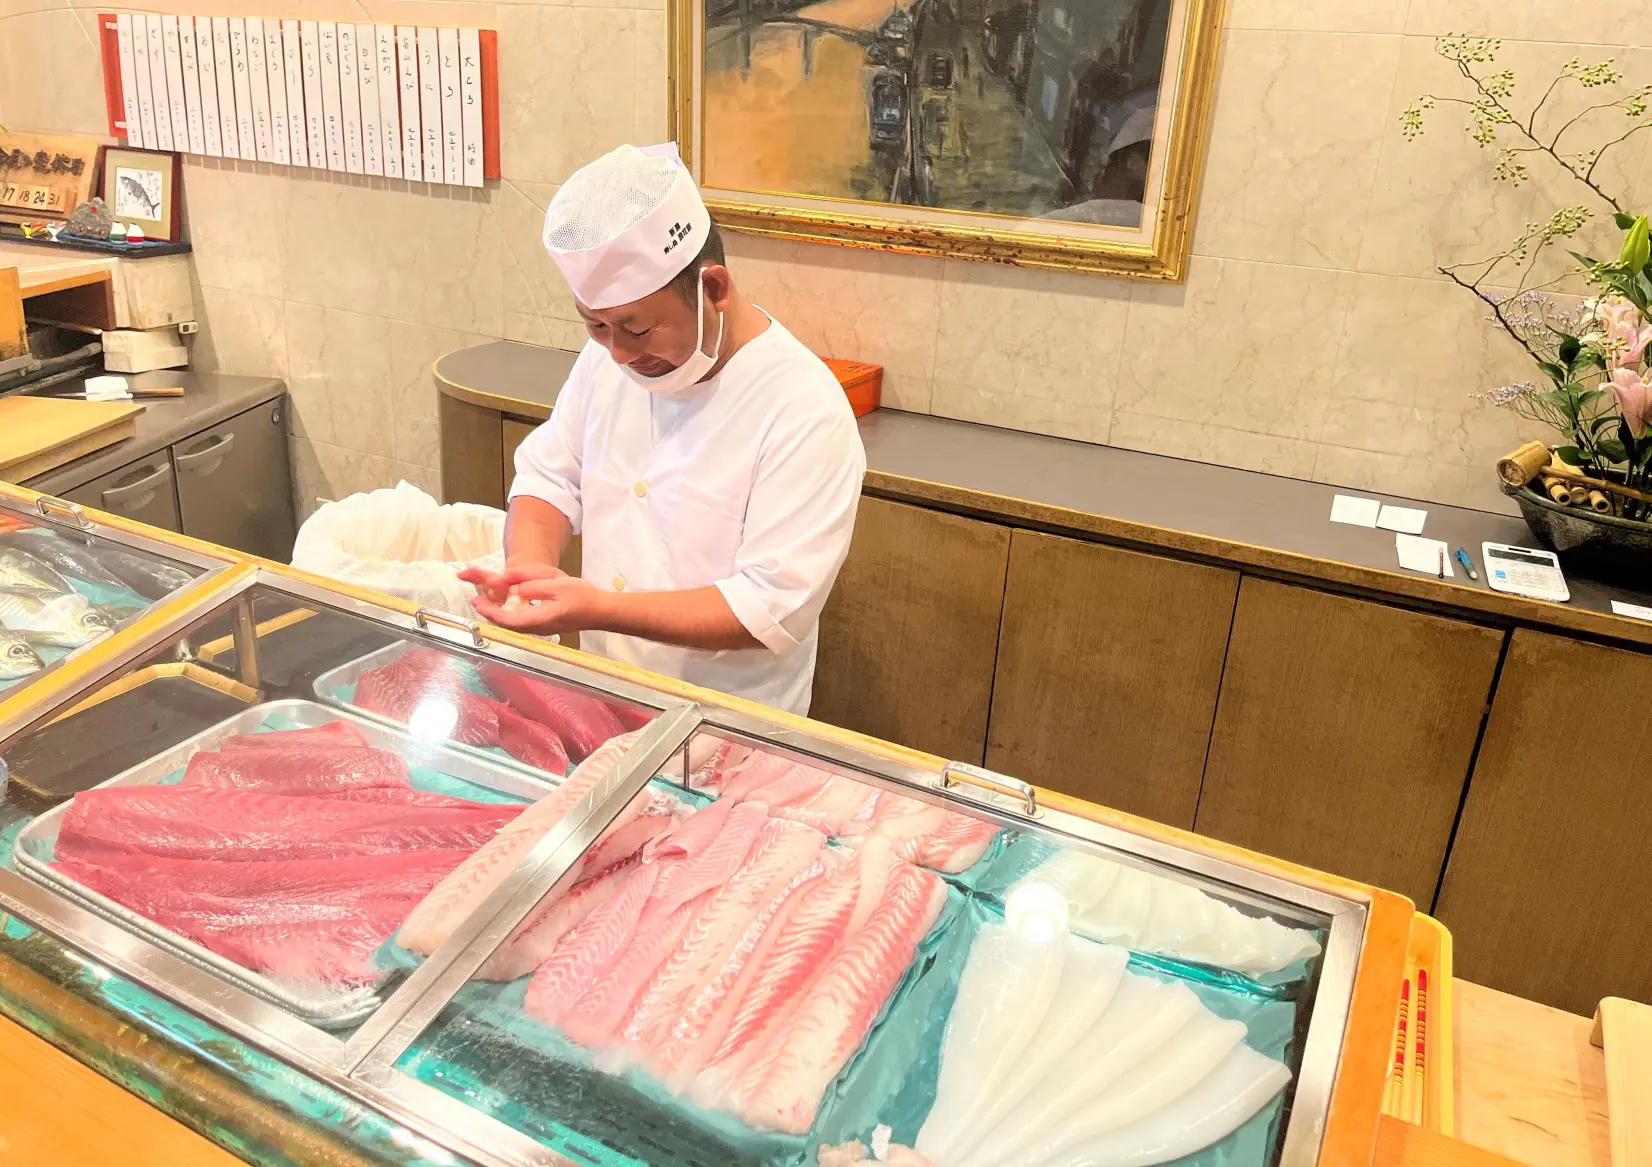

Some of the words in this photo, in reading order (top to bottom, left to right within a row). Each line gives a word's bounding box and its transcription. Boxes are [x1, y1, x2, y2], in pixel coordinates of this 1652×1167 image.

[342, 32, 352, 75] のどぐろ
[445, 56, 453, 97] とろ
[464, 56, 474, 105] 大とろ
[2, 187, 15, 201] 17
[19, 190, 30, 203] 18
[33, 190, 46, 205] 24
[48, 193, 60, 206] 31
